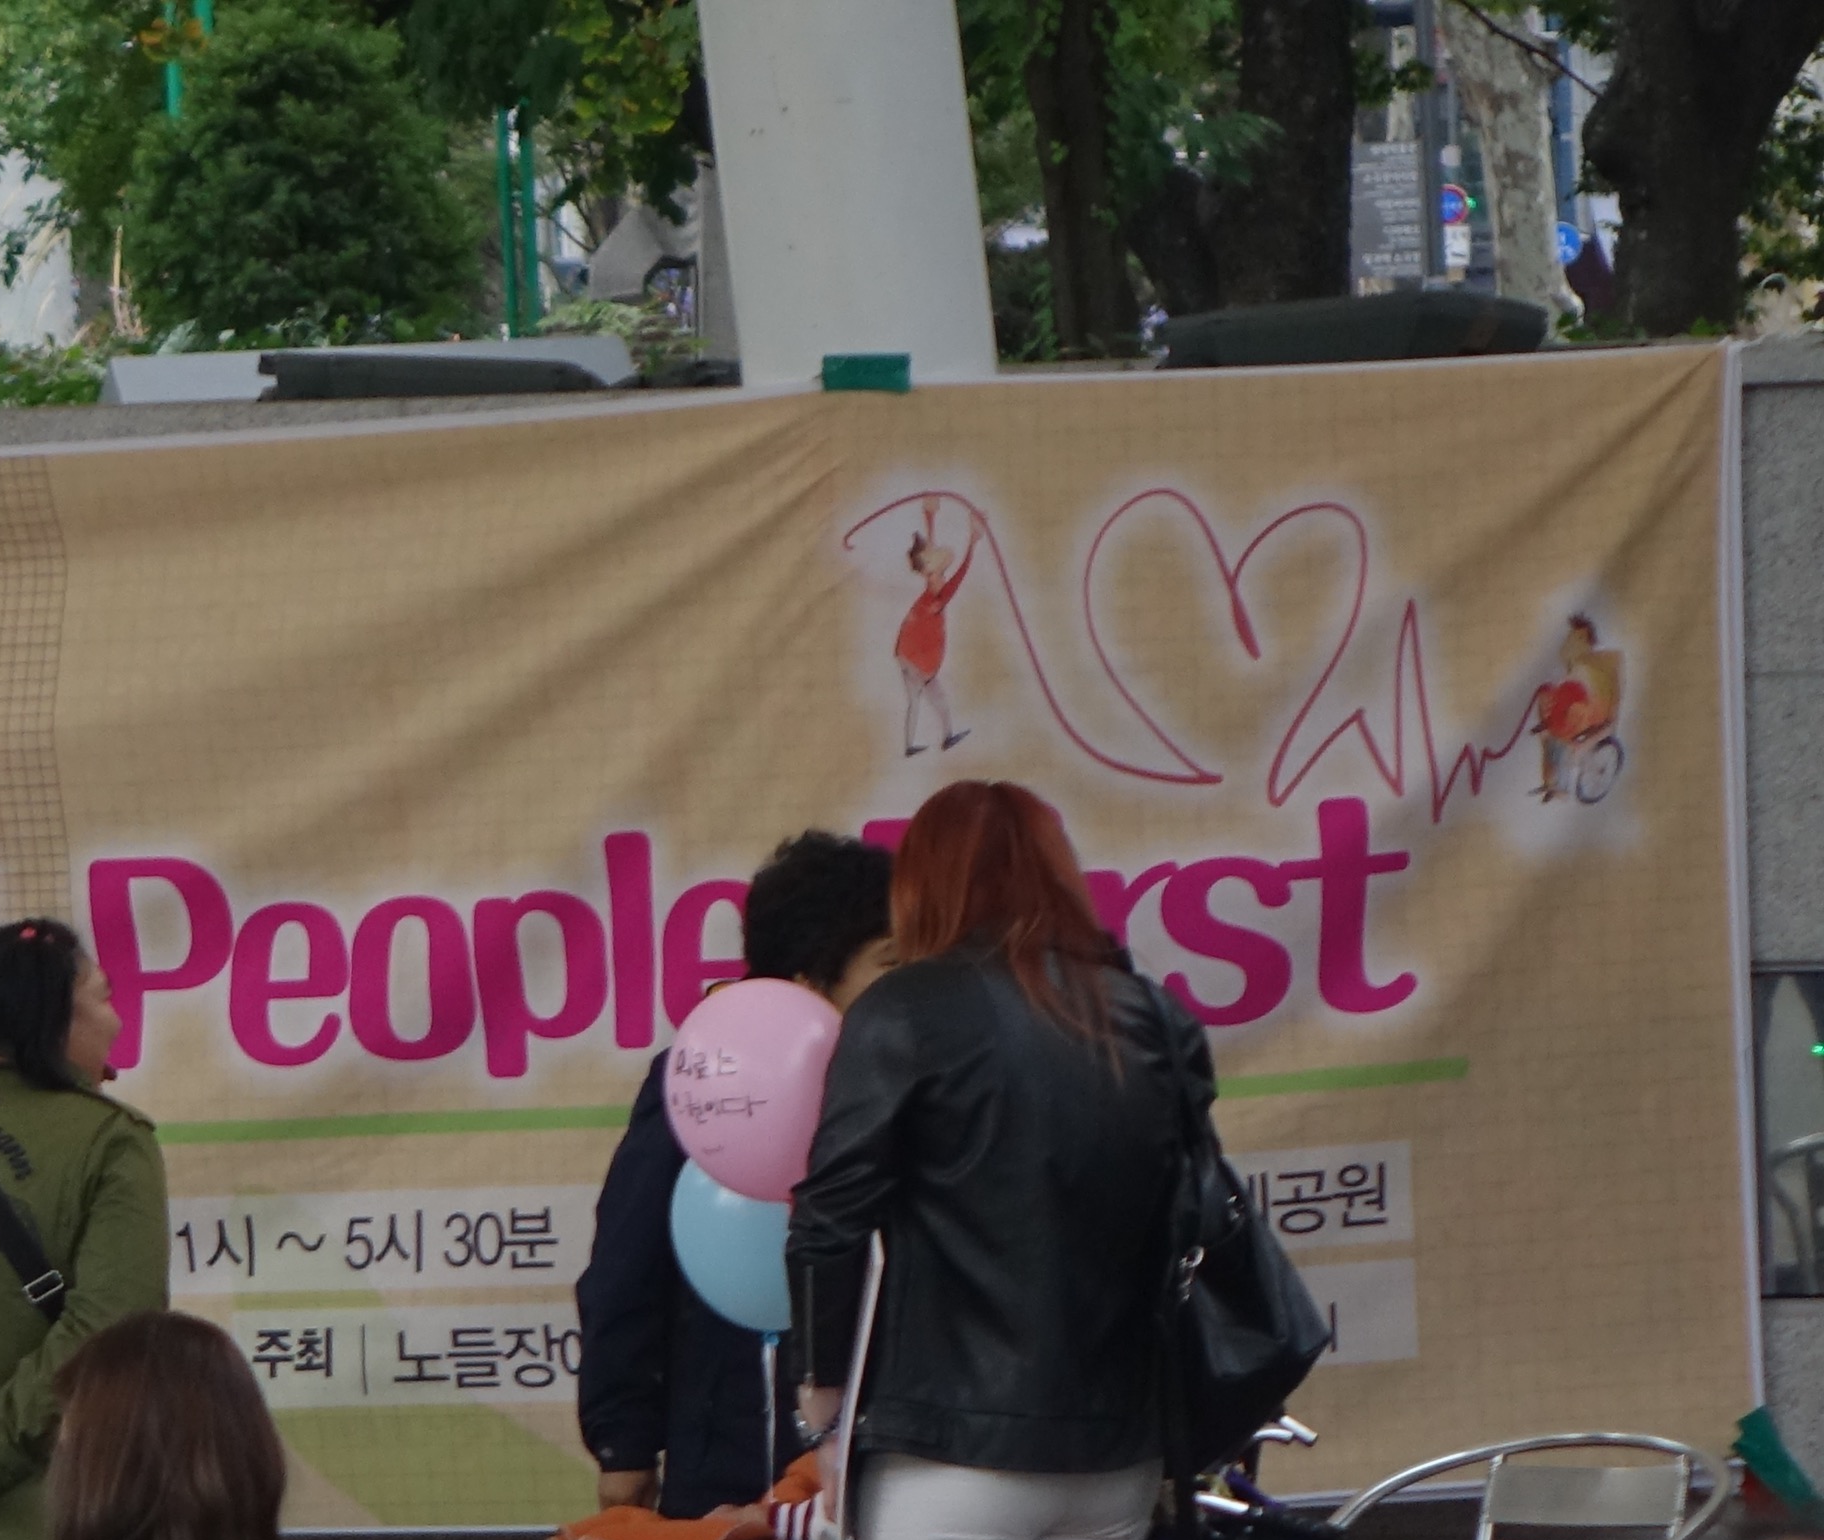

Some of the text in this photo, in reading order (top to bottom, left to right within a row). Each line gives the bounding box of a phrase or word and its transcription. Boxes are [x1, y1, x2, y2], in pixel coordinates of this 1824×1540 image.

[345, 1209, 423, 1272] 5시
[443, 1206, 559, 1269] 30분
[253, 1327, 333, 1378] 주최
